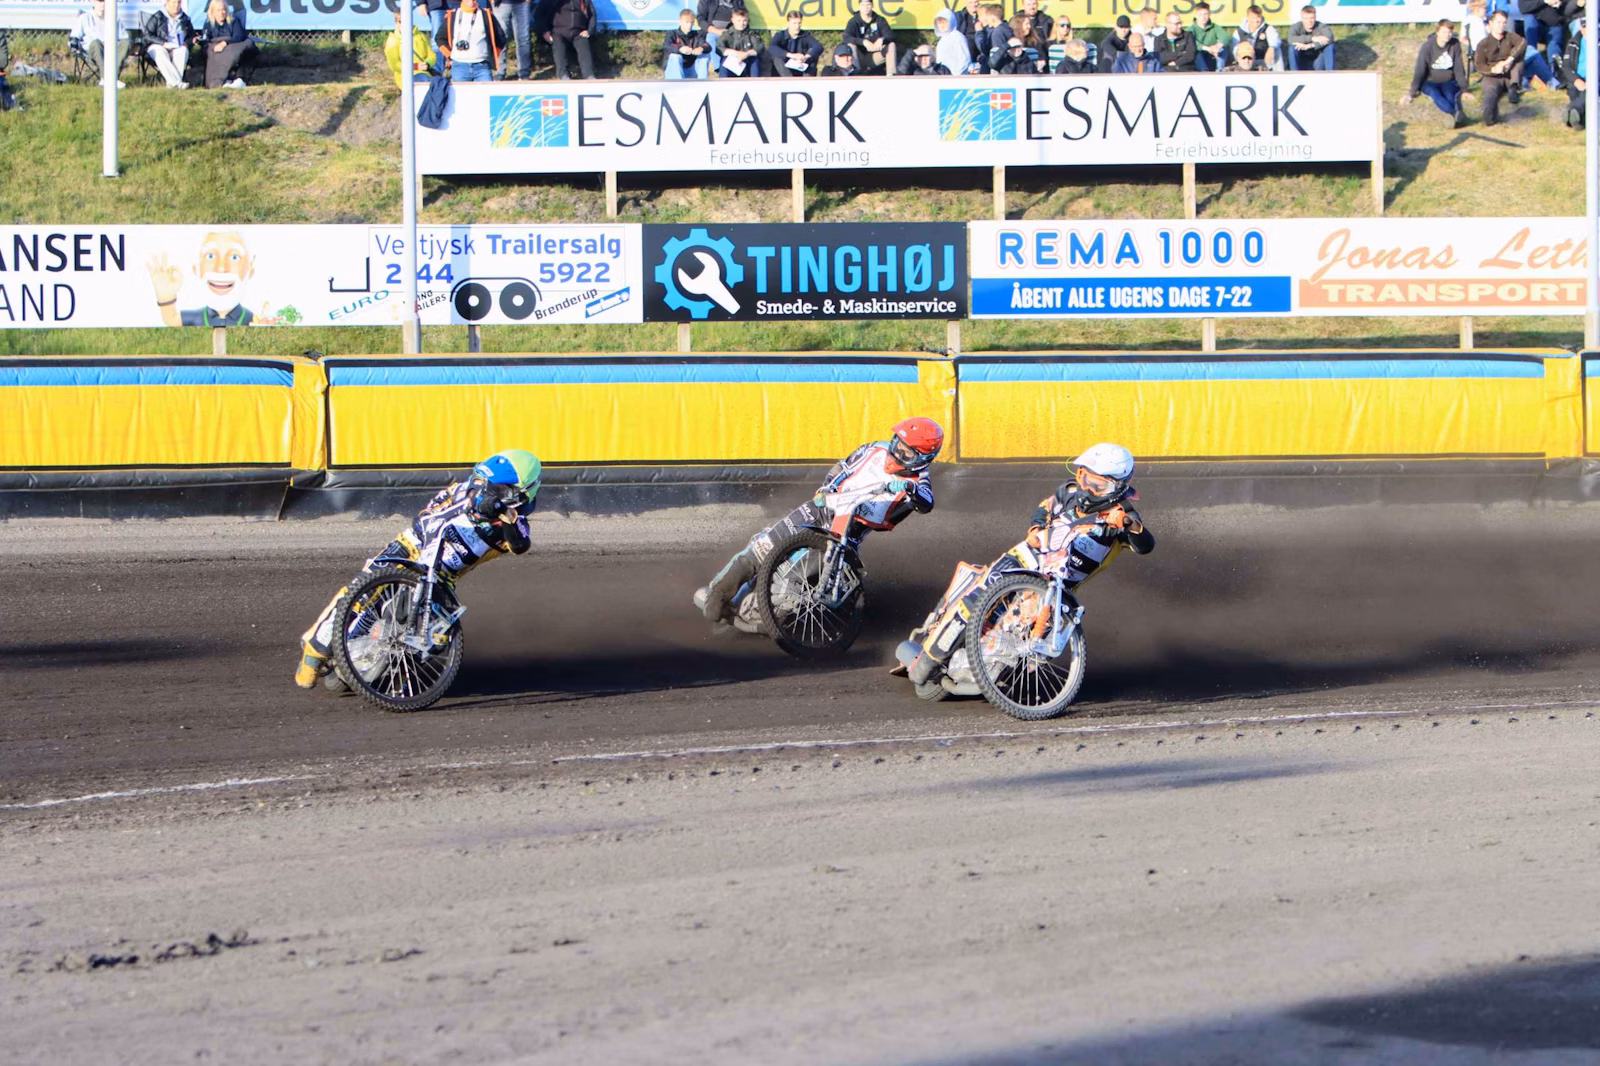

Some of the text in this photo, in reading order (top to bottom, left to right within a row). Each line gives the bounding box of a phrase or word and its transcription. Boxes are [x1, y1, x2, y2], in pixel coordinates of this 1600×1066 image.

[577, 90, 867, 147] ESMARK
[1025, 84, 1310, 141] ESMARK
[709, 148, 870, 166] Feriehusudlejning
[1155, 140, 1313, 160] Feriehusudlejning
[0, 233, 125, 272] NSEN
[375, 233, 621, 260] Vetjysk Trailersalg
[998, 230, 1265, 266] REMA 1000
[1309, 228, 1459, 284] Jonas
[385, 262, 610, 284] 244 5922
[747, 243, 955, 294] TINGHØJ
[329, 289, 390, 320] EURO
[534, 288, 598, 320] Brenderup
[756, 298, 957, 315] Smede- & Maskinservice
[1010, 282, 1252, 308] ÅBENT ALLE UGENS DAGE 7-22
[1321, 283, 1584, 302] TRANSPORT
